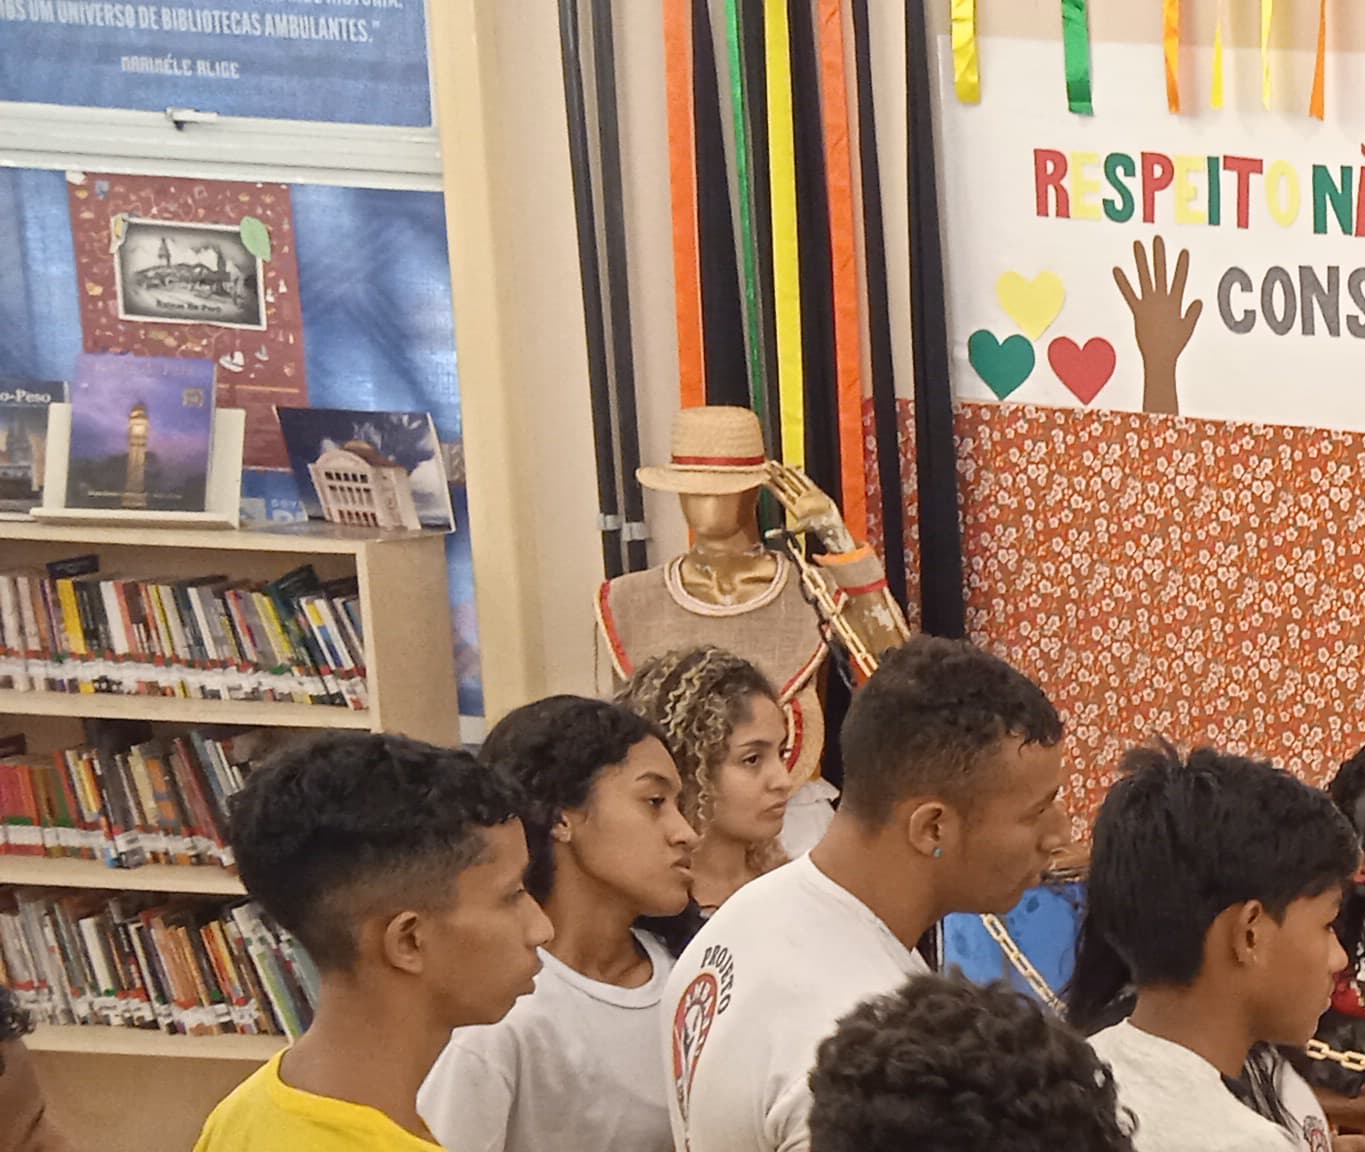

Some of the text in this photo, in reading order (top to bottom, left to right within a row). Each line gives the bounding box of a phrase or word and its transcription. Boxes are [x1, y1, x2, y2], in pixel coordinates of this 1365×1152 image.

[30, 3, 55, 22] UM
[57, 3, 136, 28] UNIVERSO
[138, 6, 160, 31] DE
[161, 7, 261, 36] BIBLIOTECAS
[1034, 147, 1300, 230] RESPEITO
[700, 945, 735, 1014] PROJETO
